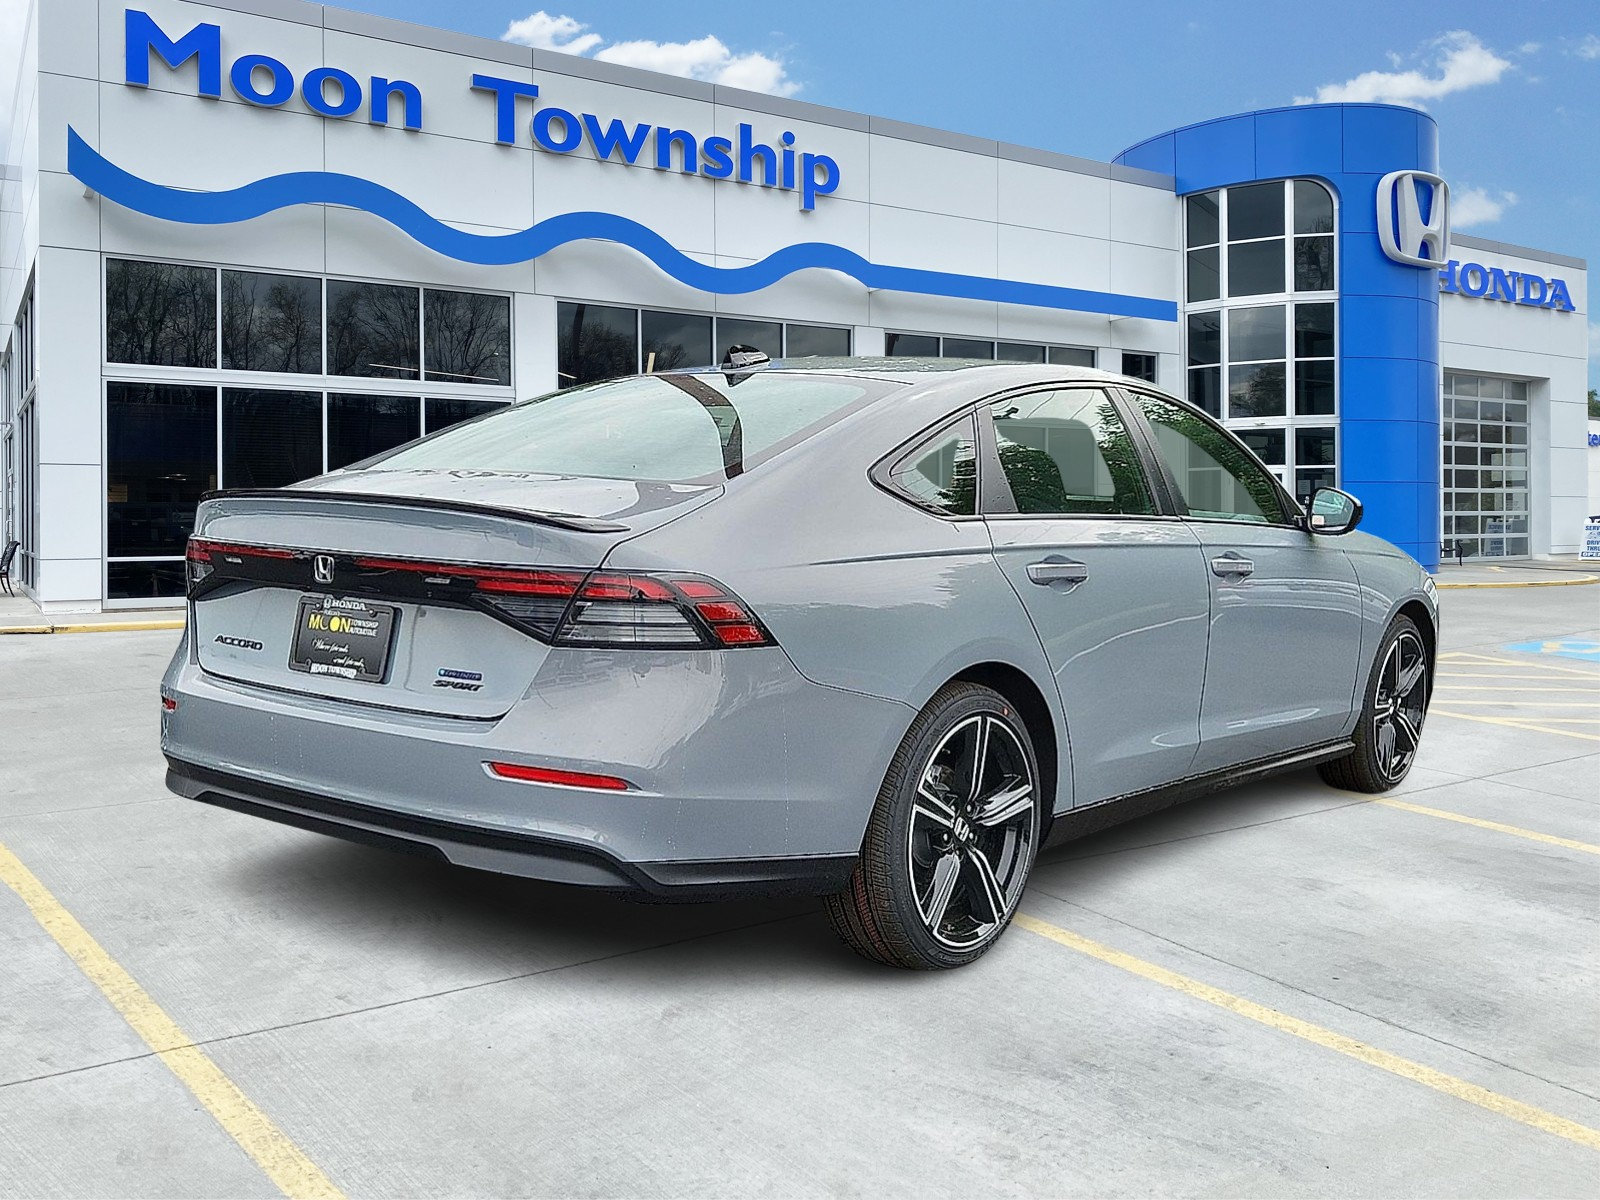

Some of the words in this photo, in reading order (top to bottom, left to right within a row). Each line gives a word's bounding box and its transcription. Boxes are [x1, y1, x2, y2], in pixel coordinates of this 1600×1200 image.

[124, 9, 422, 132] Moon
[470, 73, 841, 212] Township
[332, 599, 367, 611] HONDA
[308, 613, 351, 633] MOON
[214, 634, 263, 651] ACCORD
[432, 679, 484, 691] SPORT
